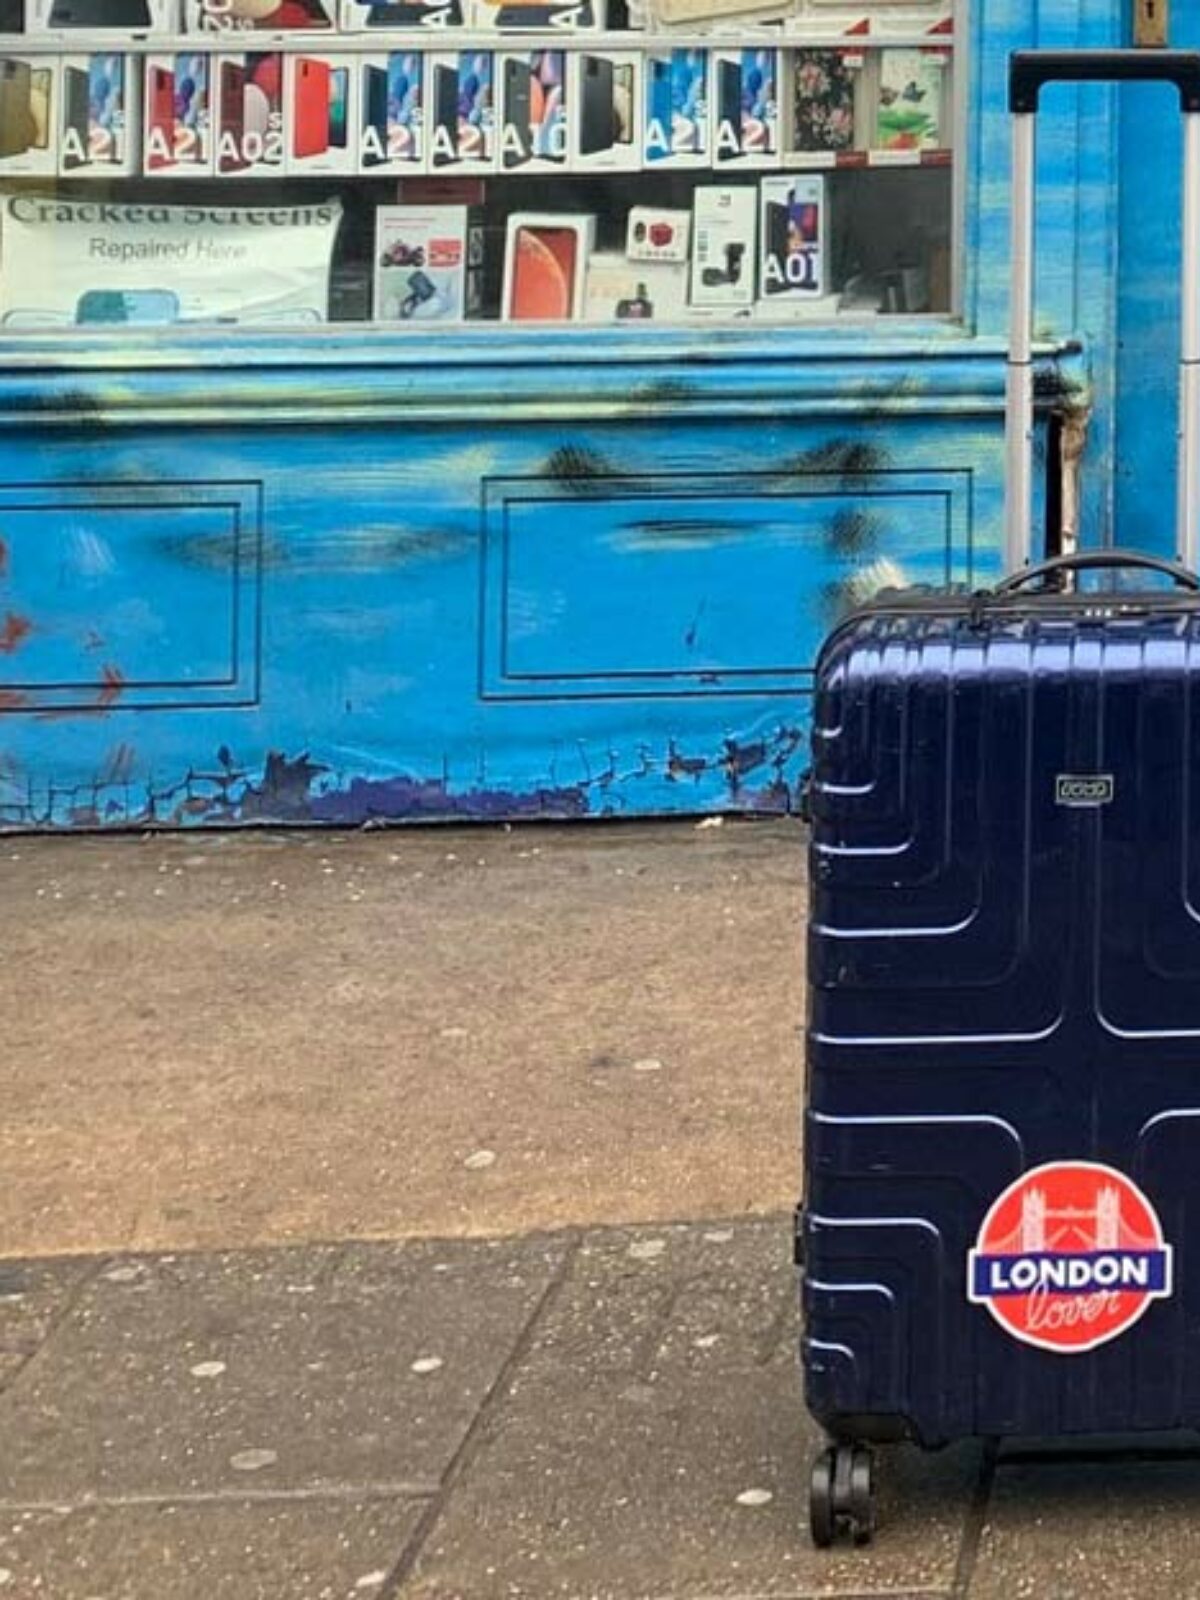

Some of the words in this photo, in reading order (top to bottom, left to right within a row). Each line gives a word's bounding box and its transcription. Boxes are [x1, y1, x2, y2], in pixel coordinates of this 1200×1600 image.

[88, 238, 188, 261] Repaired
[991, 1256, 1148, 1288] LONDON
[1026, 1281, 1121, 1330] lover
